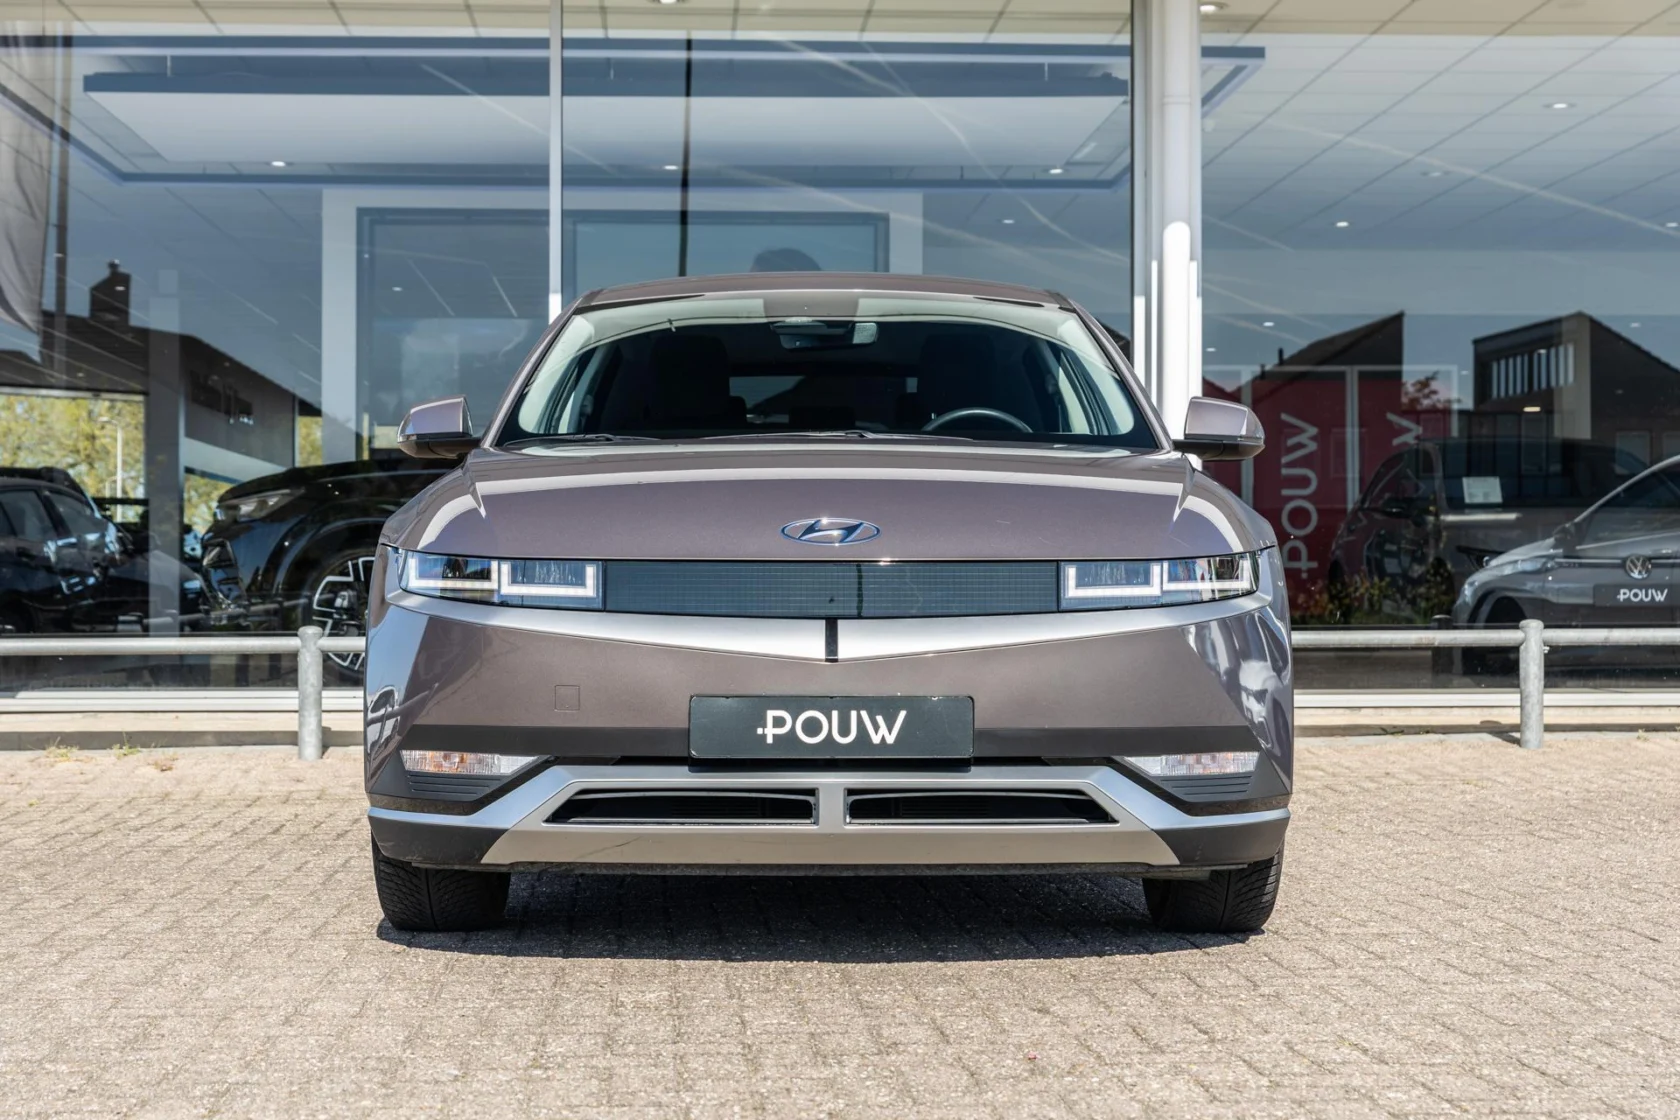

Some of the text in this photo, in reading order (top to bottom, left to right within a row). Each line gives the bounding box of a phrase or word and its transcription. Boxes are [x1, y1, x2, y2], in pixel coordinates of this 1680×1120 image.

[1280, 411, 1319, 579] POUW
[1616, 588, 1668, 602] POUW
[756, 709, 908, 745] POUW
